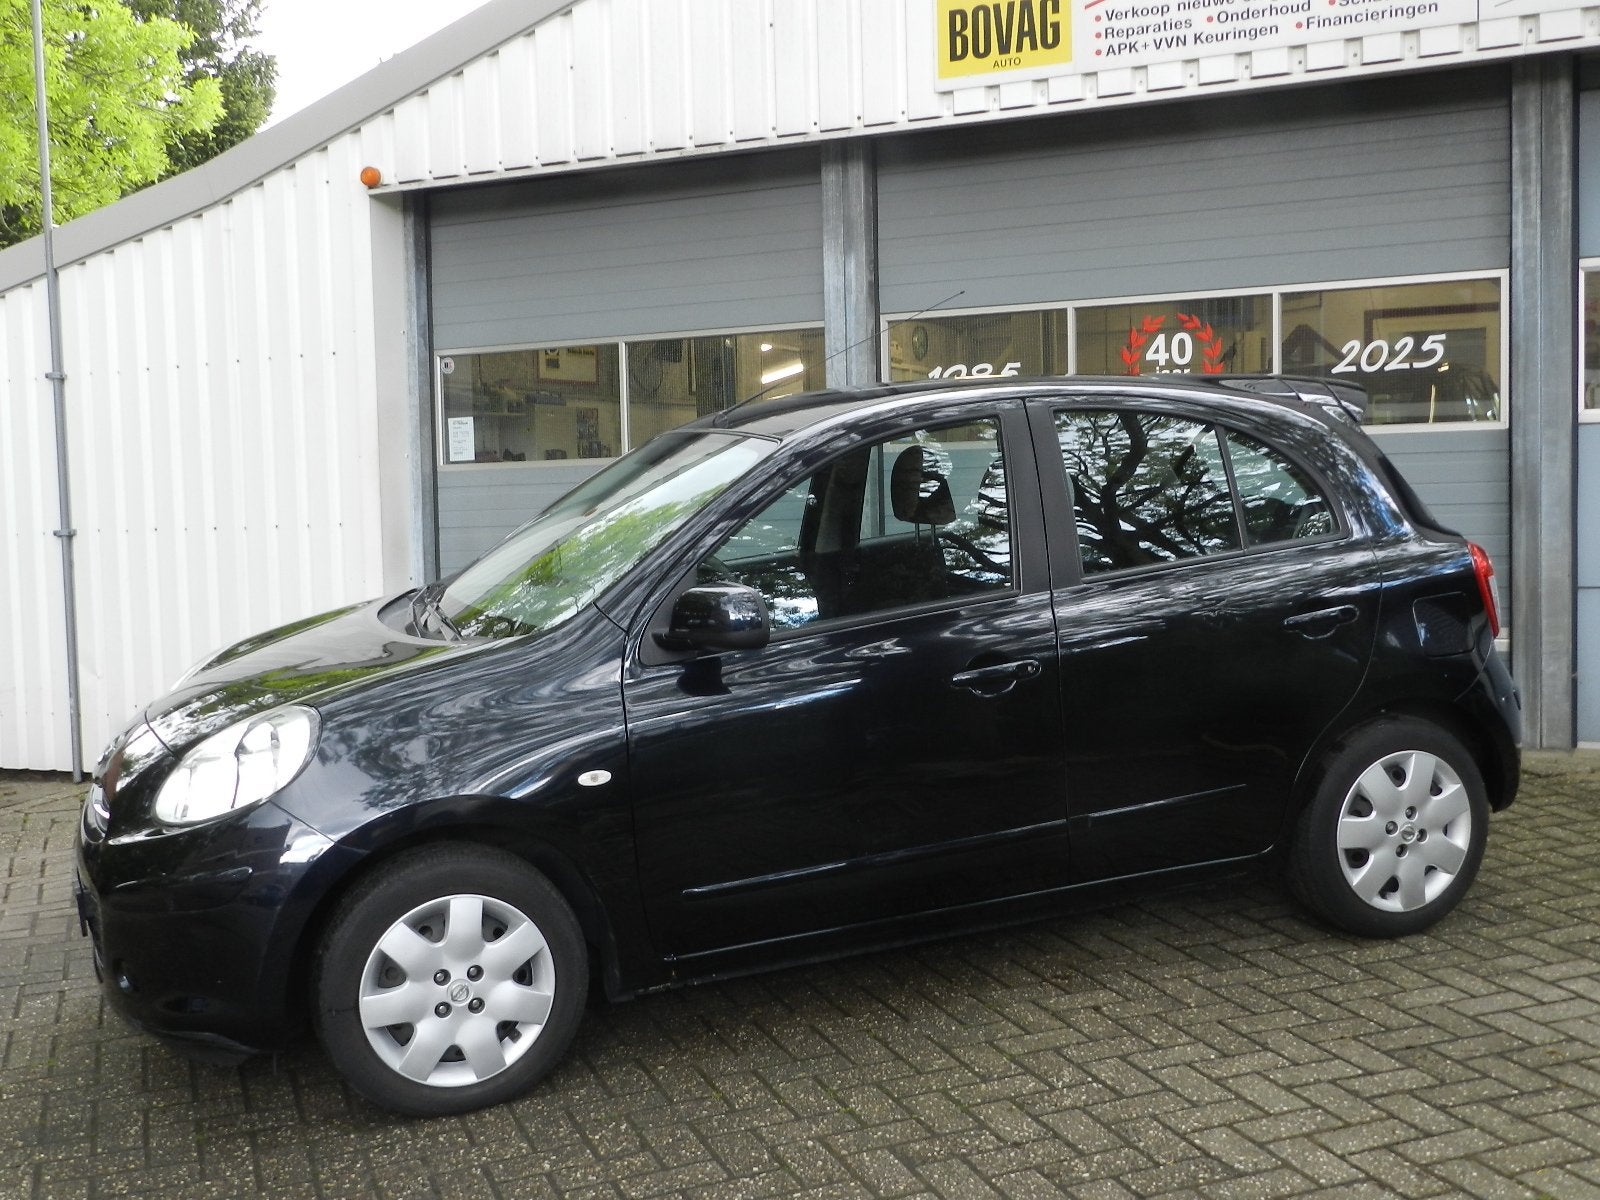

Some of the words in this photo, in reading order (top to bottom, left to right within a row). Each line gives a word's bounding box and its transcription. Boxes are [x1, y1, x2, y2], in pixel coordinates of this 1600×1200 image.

[948, 0, 1061, 62] BOVAG
[1105, 4, 1170, 21] Verkoop
[1105, 18, 1192, 39] Reparaties
[1217, 0, 1311, 23] Onderhoud
[1193, 25, 1279, 45] Keuringen
[1306, 2, 1438, 29] Financieringen
[993, 57, 1021, 69] AUTO
[1145, 332, 1193, 366] 40
[1331, 333, 1447, 374] 2025
